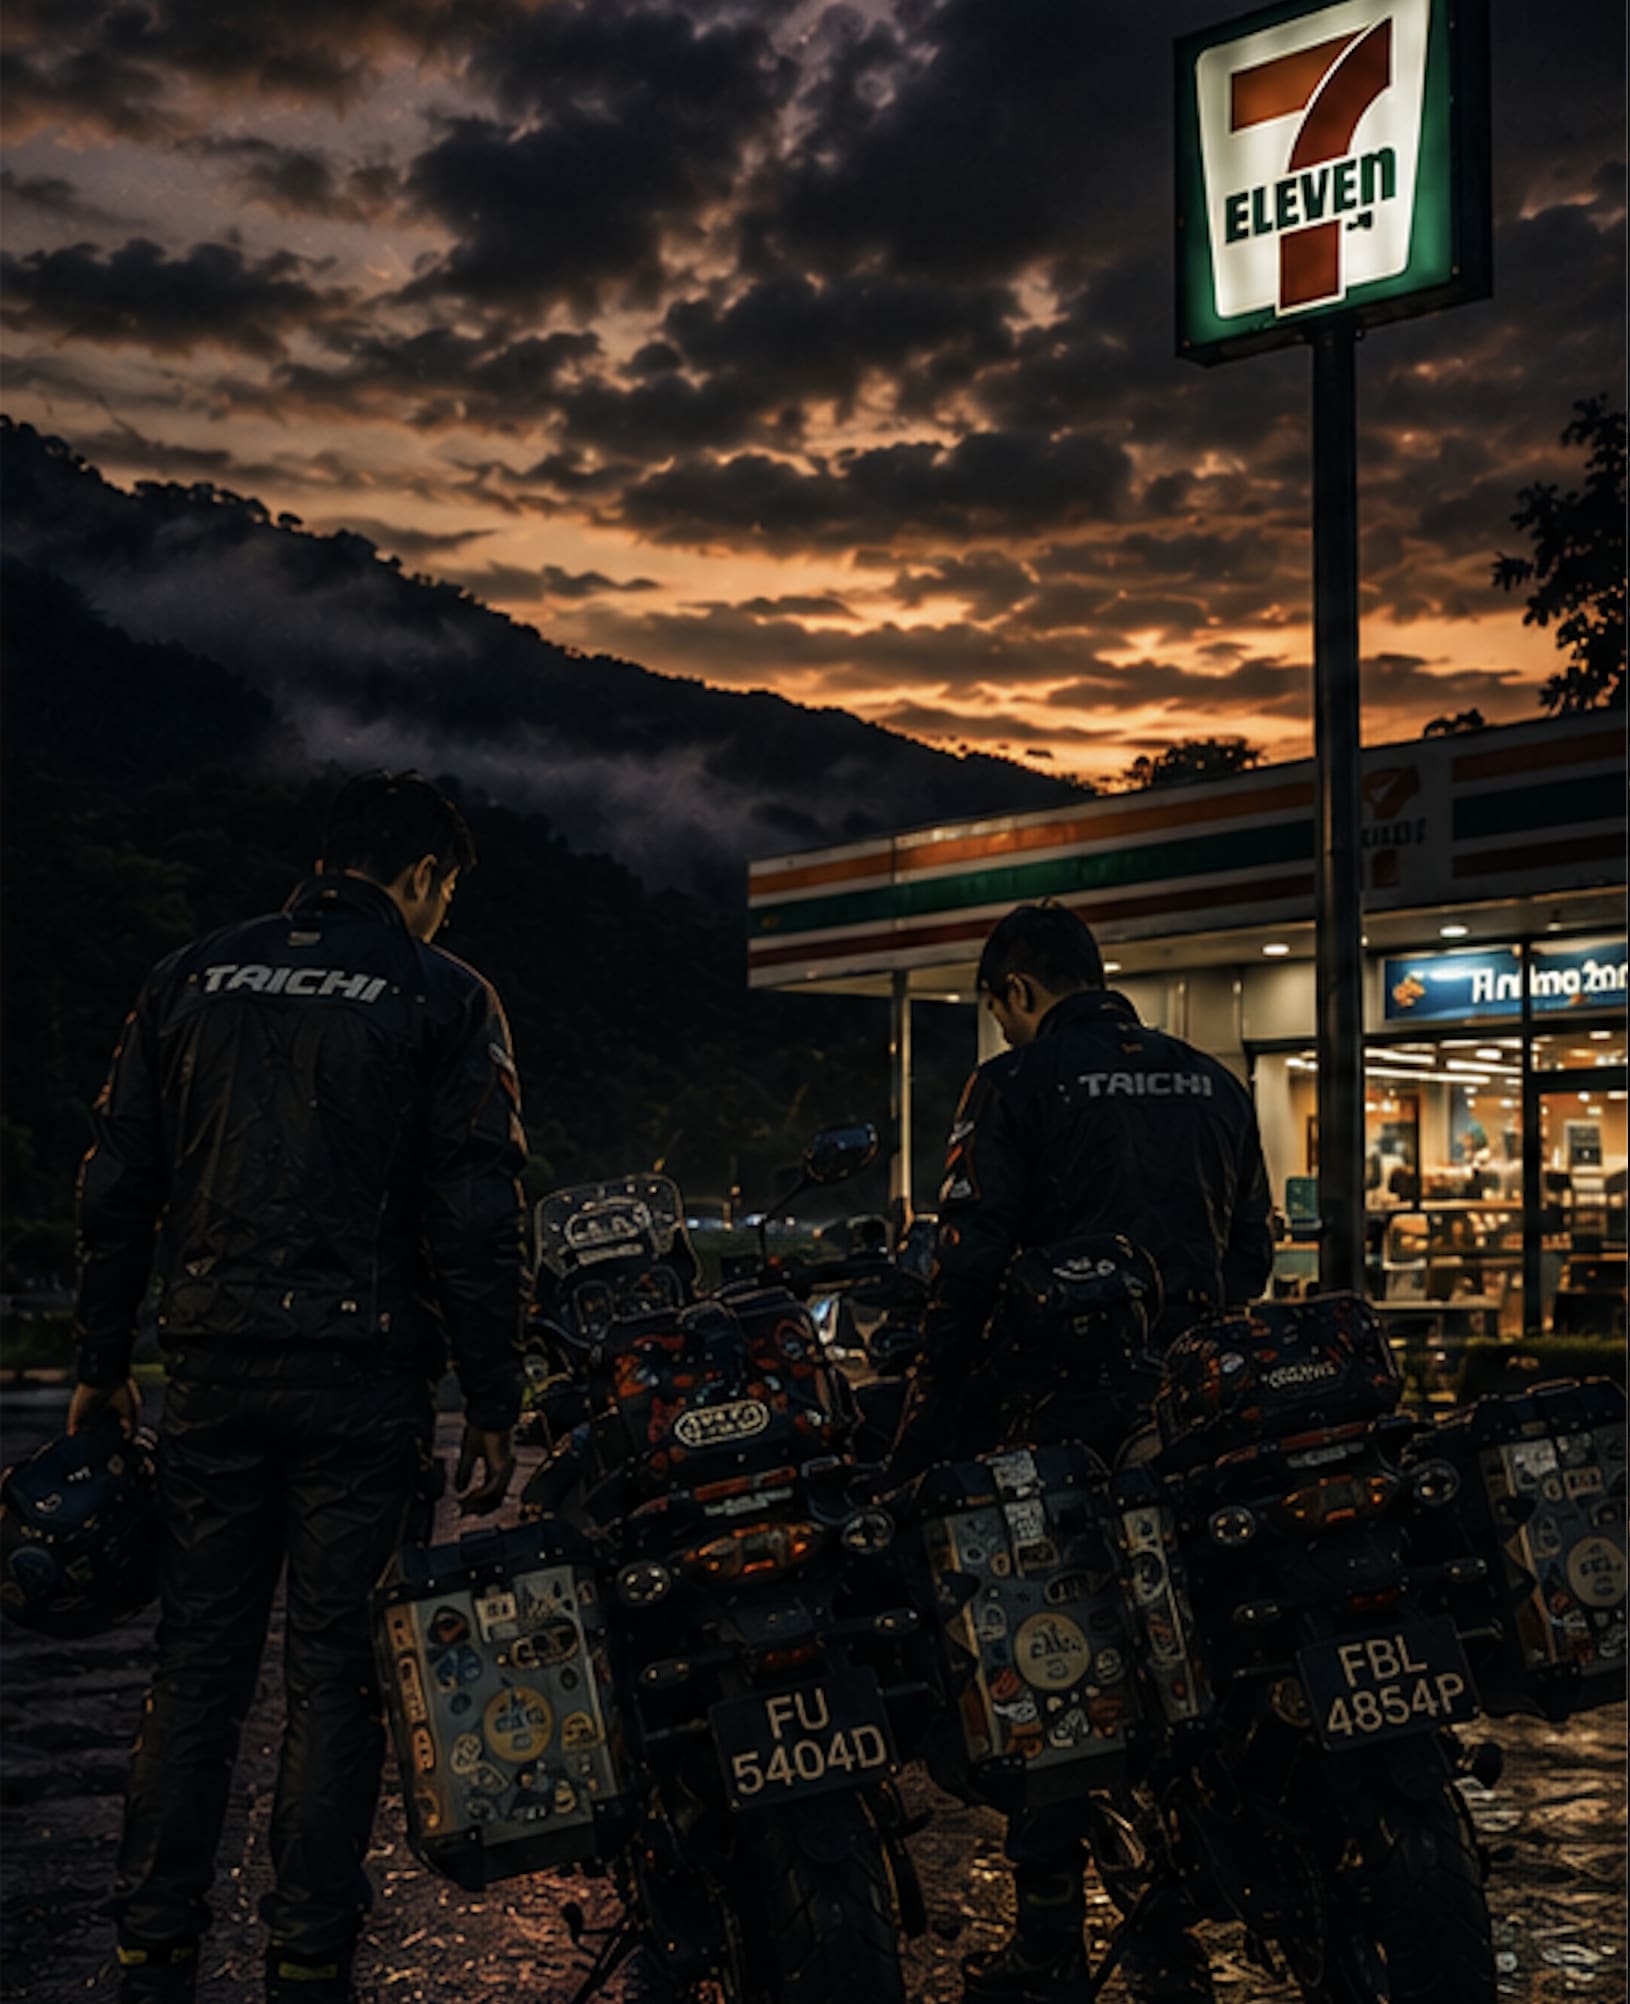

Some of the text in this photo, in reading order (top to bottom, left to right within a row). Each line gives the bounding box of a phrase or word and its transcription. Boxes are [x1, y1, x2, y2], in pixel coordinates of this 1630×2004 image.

[1231, 17, 1393, 310] 7
[204, 964, 388, 1003] TAICHI
[1078, 1072, 1213, 1097] TAICHI
[1337, 1632, 1429, 1688] FBL
[765, 1687, 831, 1740] FU
[1327, 1671, 1465, 1738] 4854P
[731, 1724, 888, 1796] 5404D
